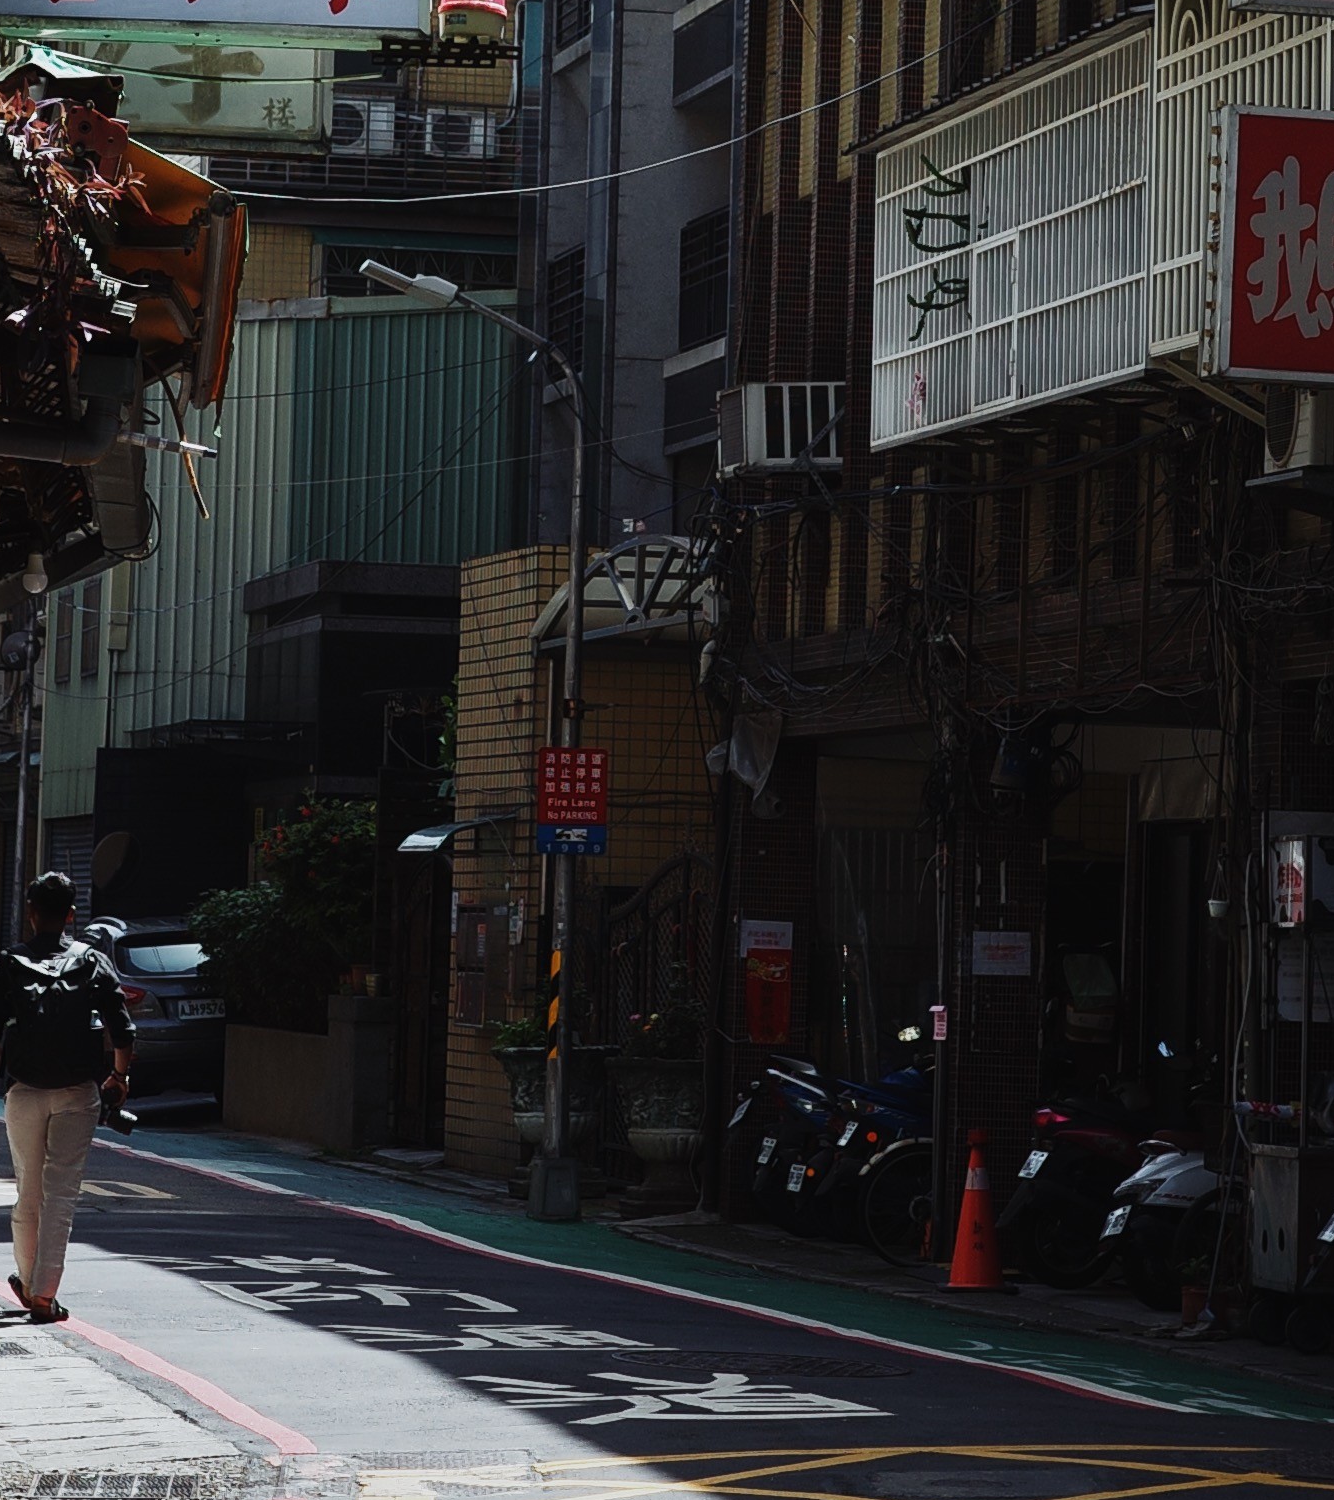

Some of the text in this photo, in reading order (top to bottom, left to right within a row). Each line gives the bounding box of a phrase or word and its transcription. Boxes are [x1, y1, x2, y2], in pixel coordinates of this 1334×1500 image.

[547, 797, 596, 808] Fire Lane
[560, 811, 599, 821] PARKING
[545, 843, 601, 853] 1999
[112, 1252, 897, 1427] 消防通道
